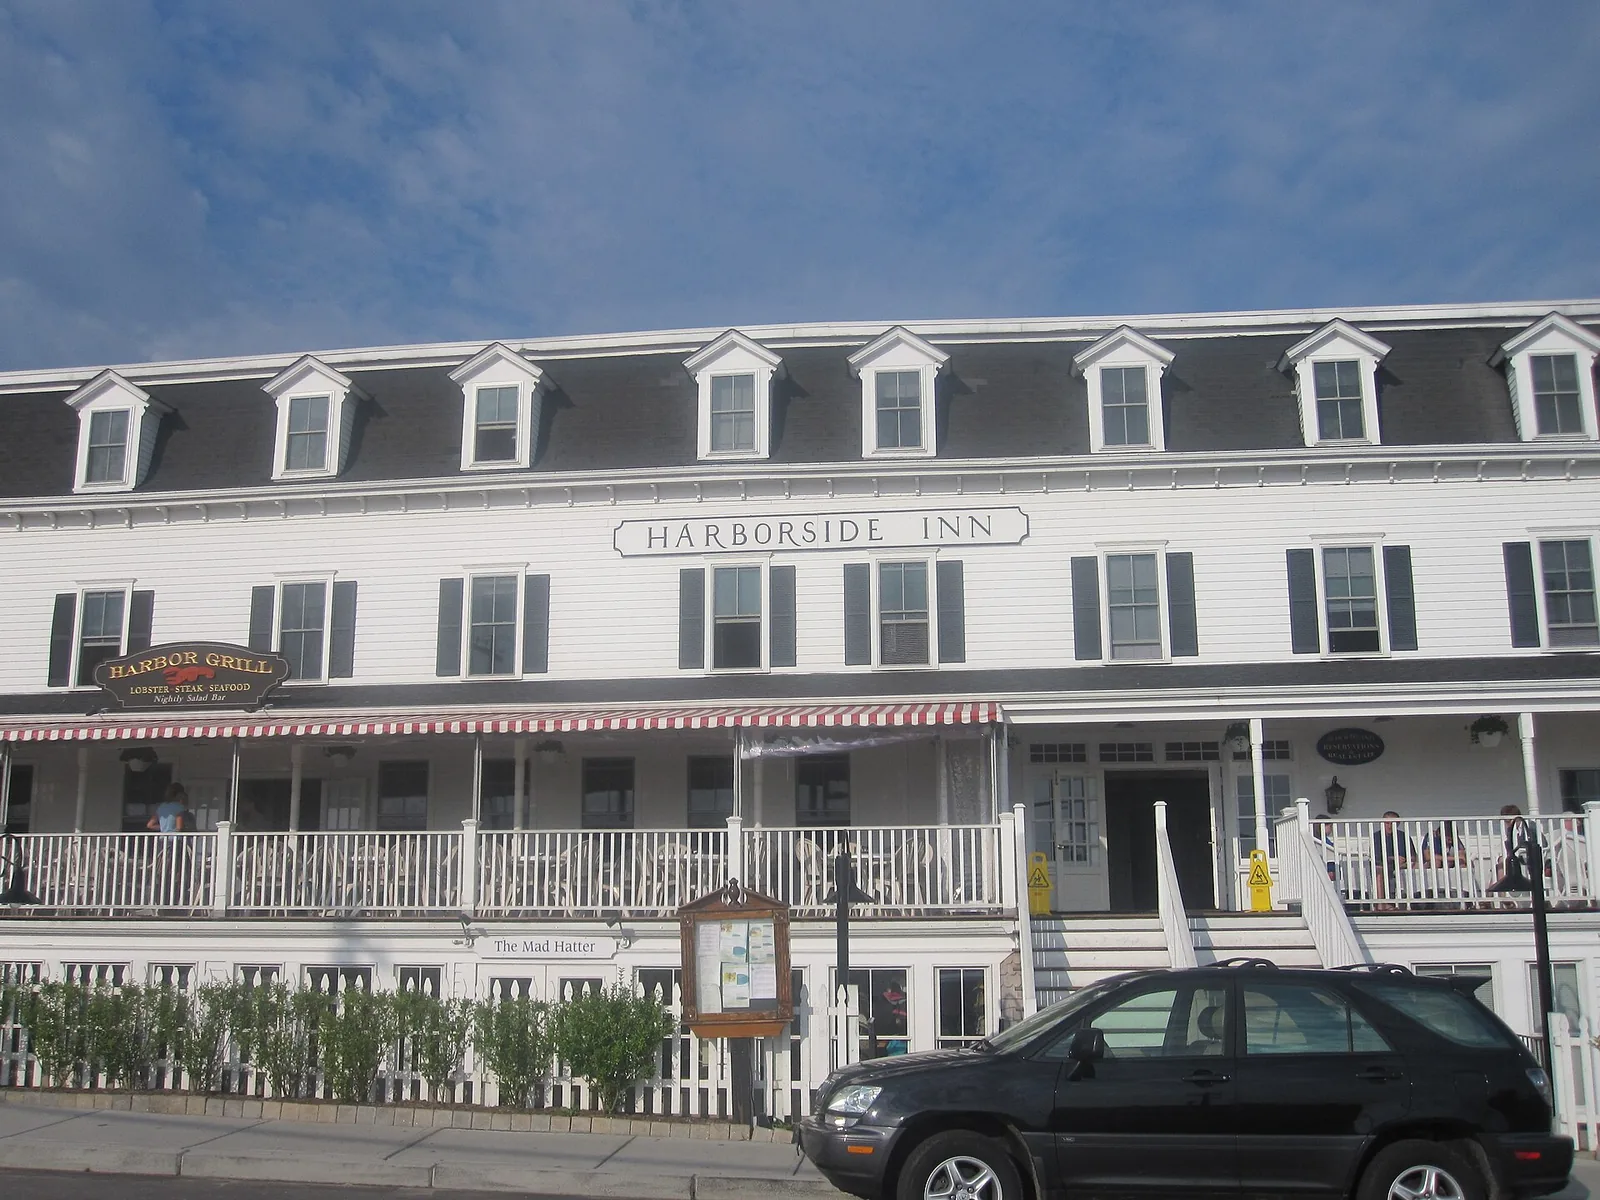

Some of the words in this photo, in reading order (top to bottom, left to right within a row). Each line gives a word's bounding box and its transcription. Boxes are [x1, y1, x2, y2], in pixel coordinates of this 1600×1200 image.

[647, 518, 884, 550] HARBORSIDE
[923, 515, 993, 540] INN
[109, 651, 198, 679] HARBOR
[205, 652, 273, 674] GRILL
[130, 685, 170, 695] LOBSTER
[175, 684, 204, 693] STEAK
[209, 683, 251, 692] SEAFOOD
[153, 694, 184, 704] Nightly
[187, 693, 208, 702] Salad
[212, 693, 226, 701] Bar
[494, 940, 518, 953] The
[522, 940, 550, 953] Mad
[554, 941, 596, 953] Hatter
